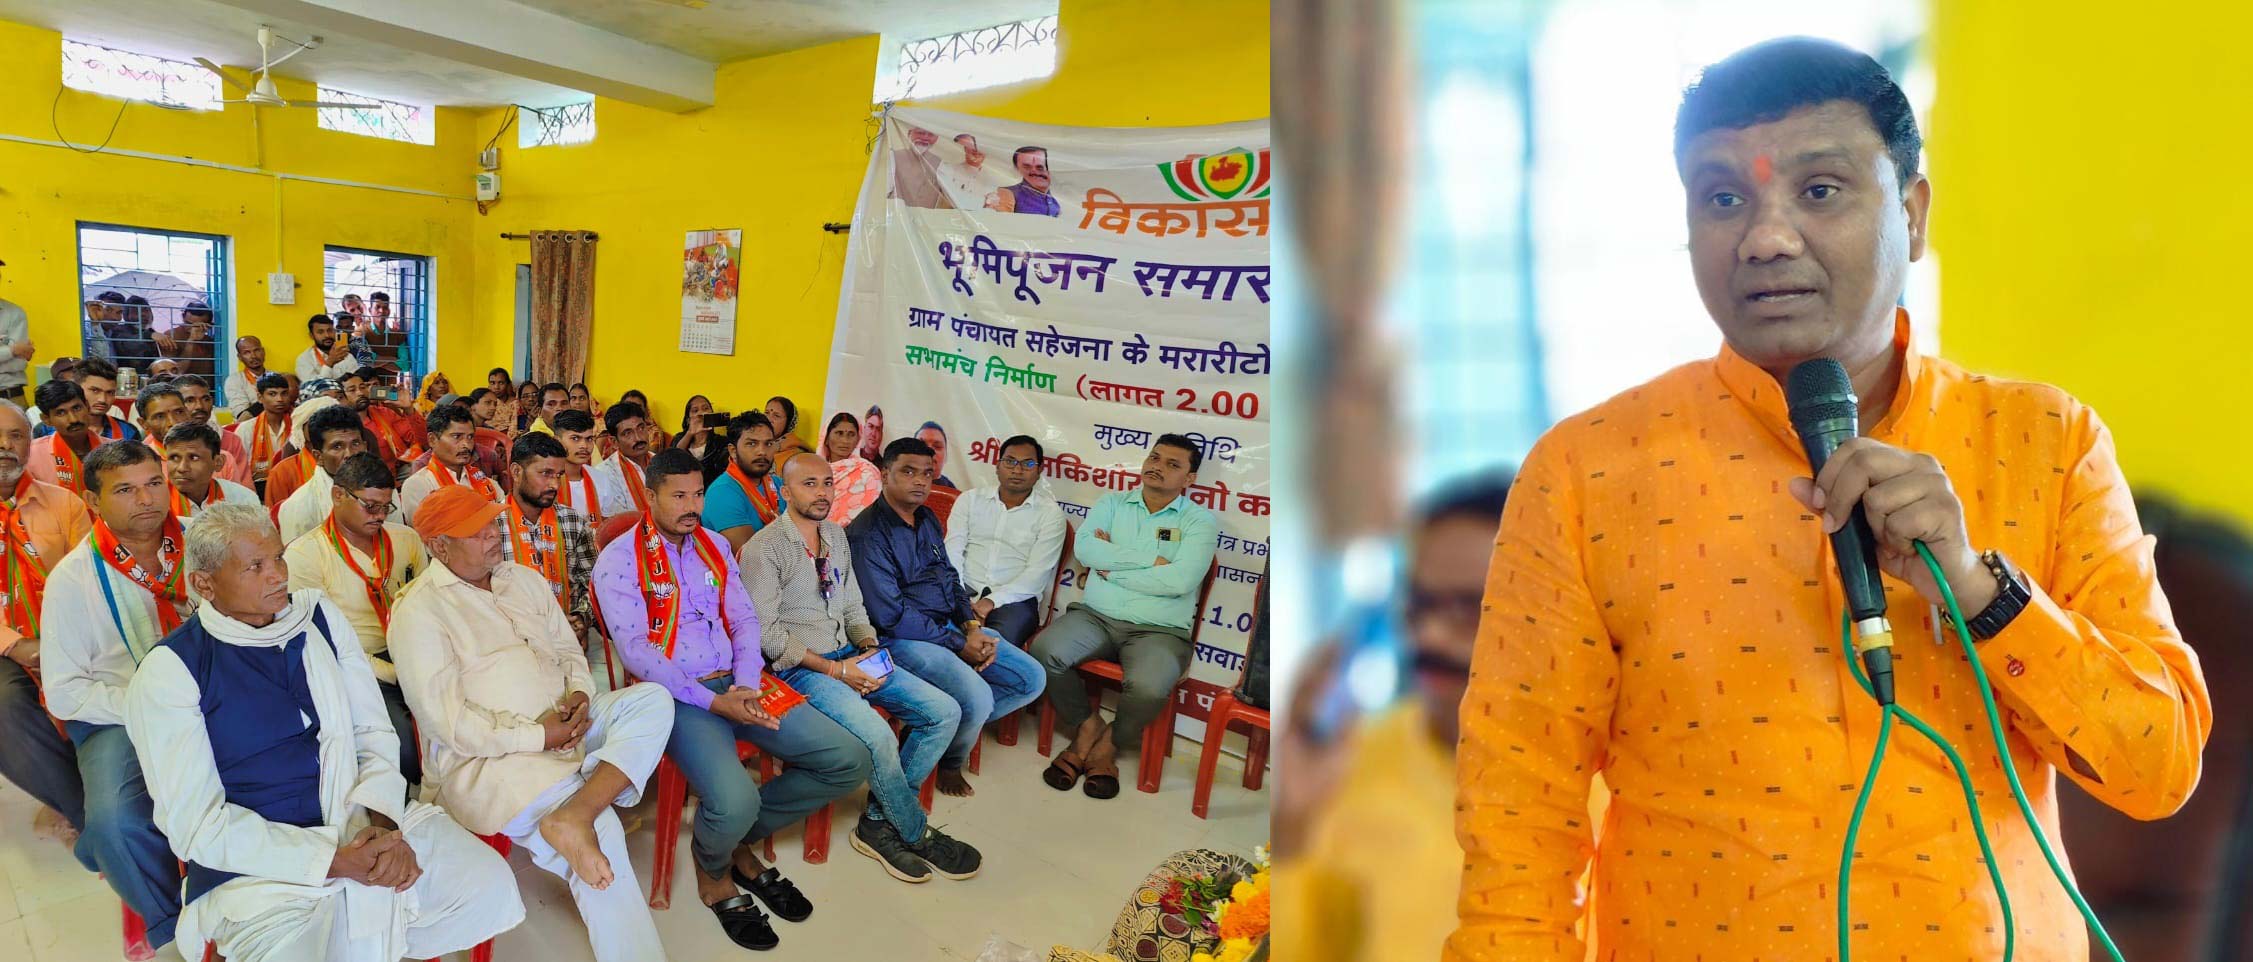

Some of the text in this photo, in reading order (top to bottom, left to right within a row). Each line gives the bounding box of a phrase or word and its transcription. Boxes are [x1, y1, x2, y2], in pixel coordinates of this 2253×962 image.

[1078, 187, 1271, 239] विकास
[938, 234, 1117, 305] भूमिपूजन
[908, 306, 945, 331] ग्राम
[950, 313, 1018, 349] पंचायत
[1025, 324, 1113, 361] सहेजना
[1121, 333, 1150, 365] के
[905, 345, 1260, 420] सभामंच निर्माण (लागत 2.00
[1093, 424, 1153, 450] मुख्य
